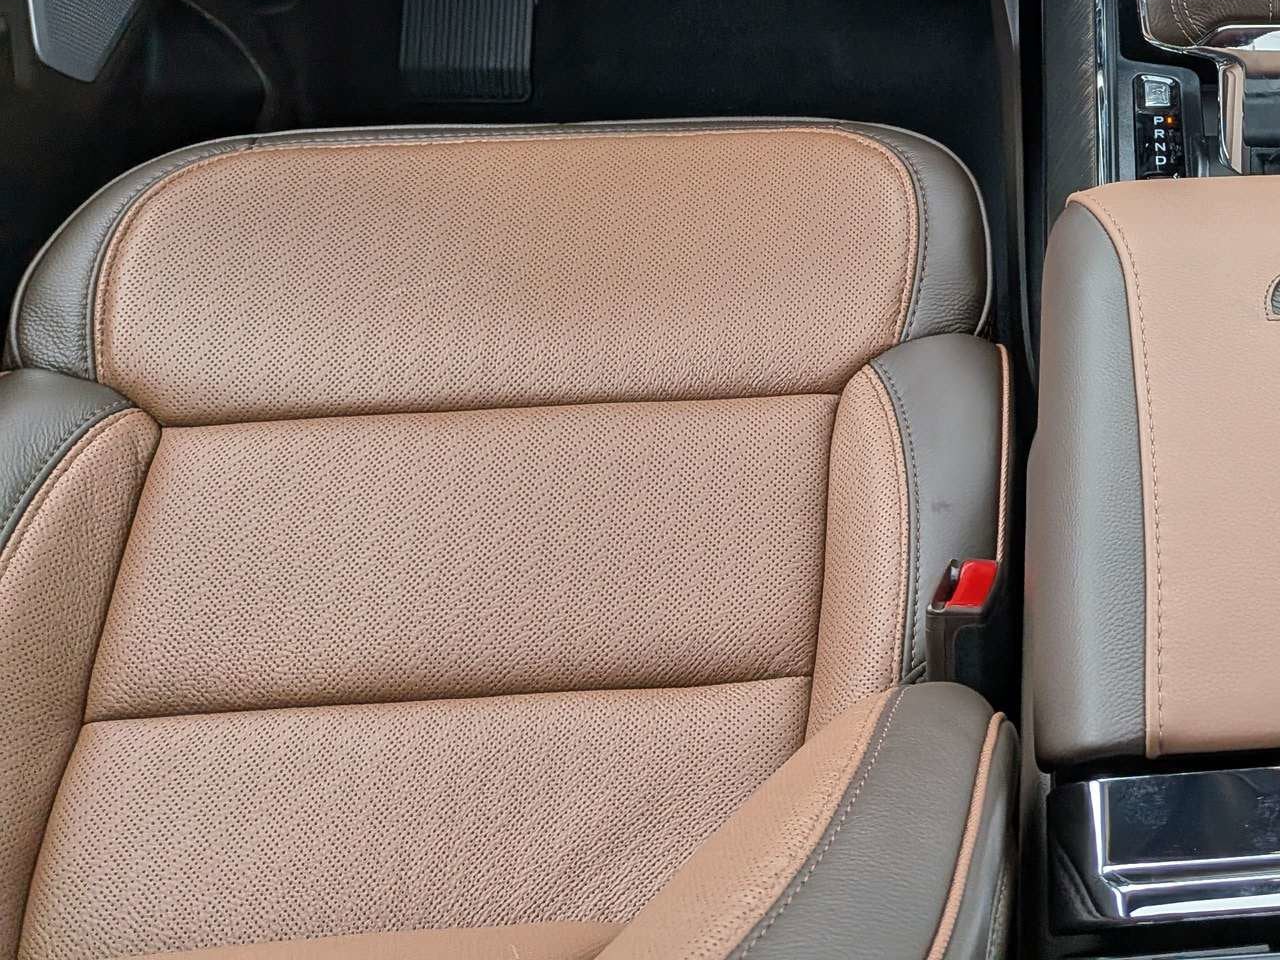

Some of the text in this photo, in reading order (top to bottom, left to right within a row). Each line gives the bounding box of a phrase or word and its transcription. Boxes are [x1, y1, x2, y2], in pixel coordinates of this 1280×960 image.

[1154, 116, 1164, 126] P
[1154, 129, 1165, 139] R
[1155, 143, 1166, 152] N
[1156, 156, 1167, 165] D
